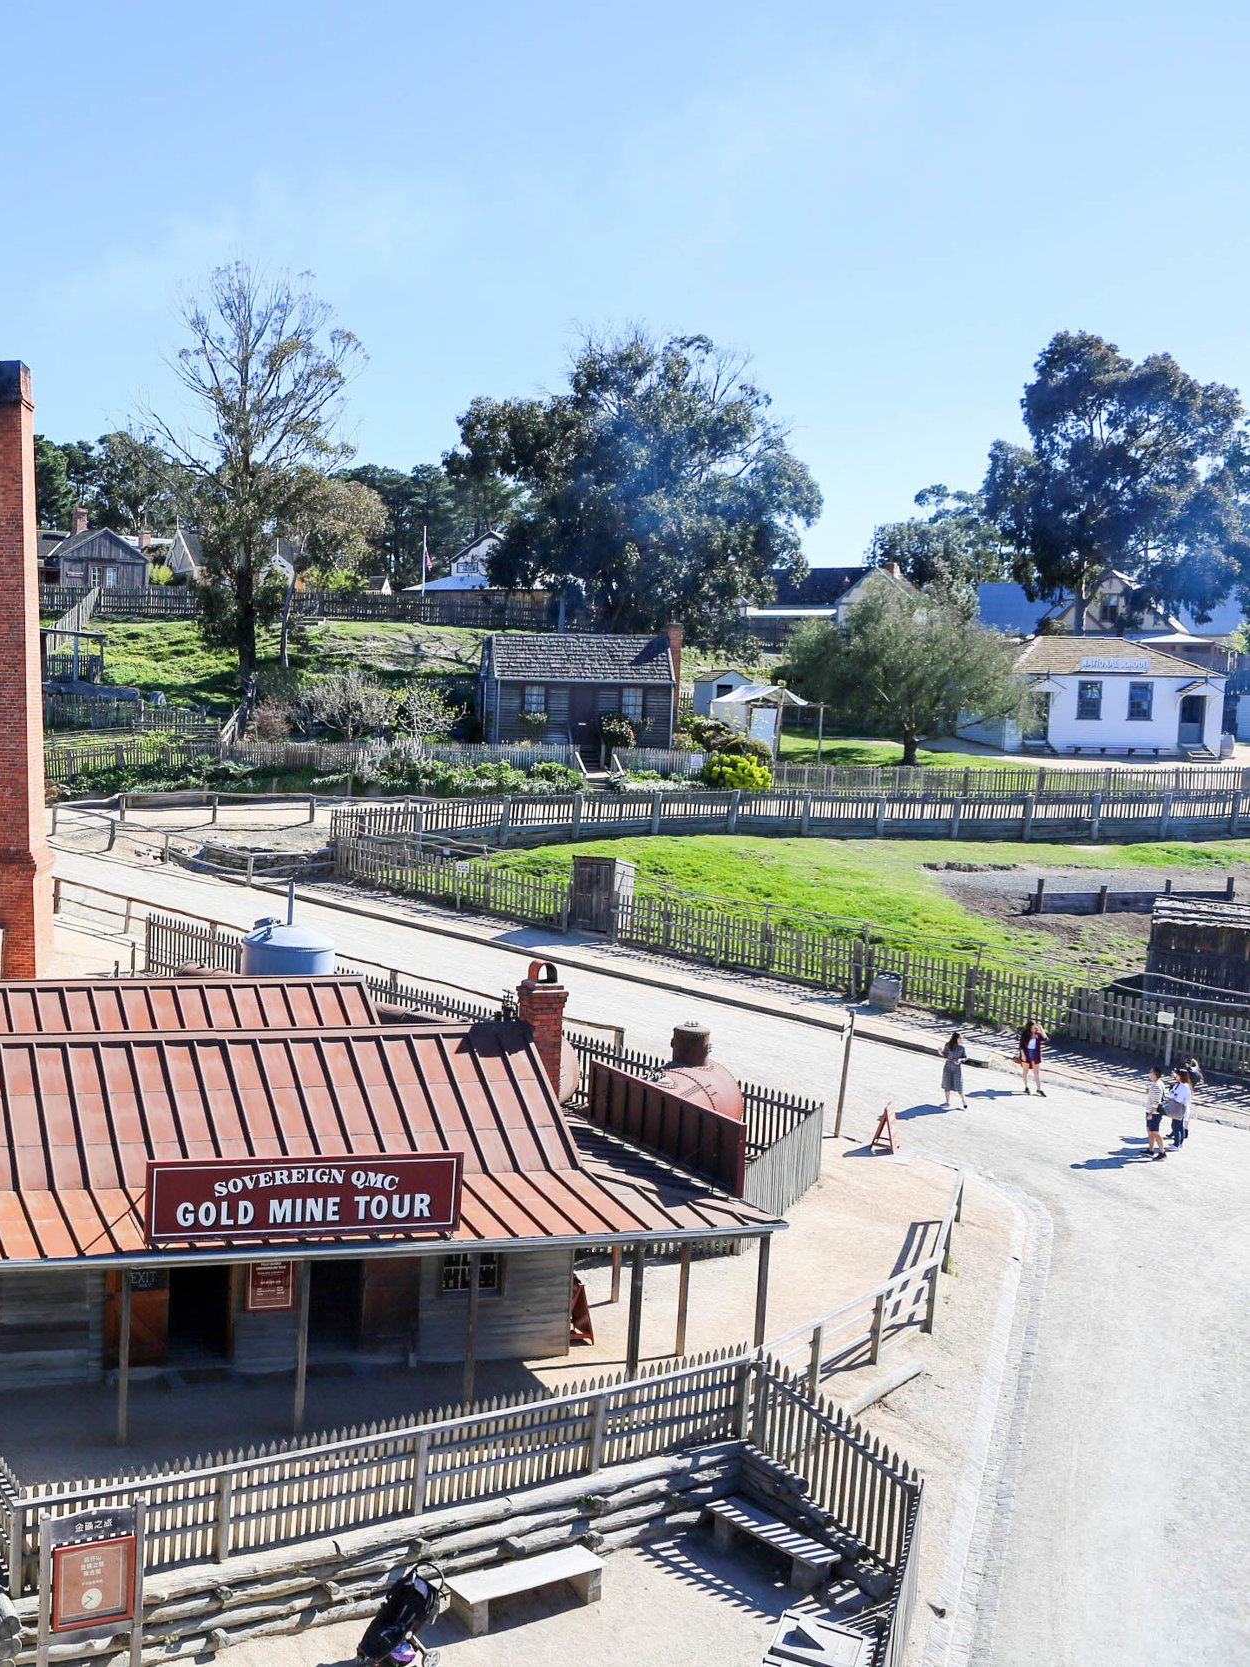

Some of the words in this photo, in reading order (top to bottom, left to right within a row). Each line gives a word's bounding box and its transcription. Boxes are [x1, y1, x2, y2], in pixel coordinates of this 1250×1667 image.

[1082, 659, 1119, 669] NATIONAL
[1120, 660, 1148, 670] SCHOOL
[213, 1168, 346, 1198] SOVEREIGN
[350, 1169, 400, 1191] QMC
[175, 1199, 255, 1228] GOLD
[268, 1196, 342, 1225] MINE
[353, 1192, 432, 1221] TOUR
[130, 1271, 157, 1284] EXIT
